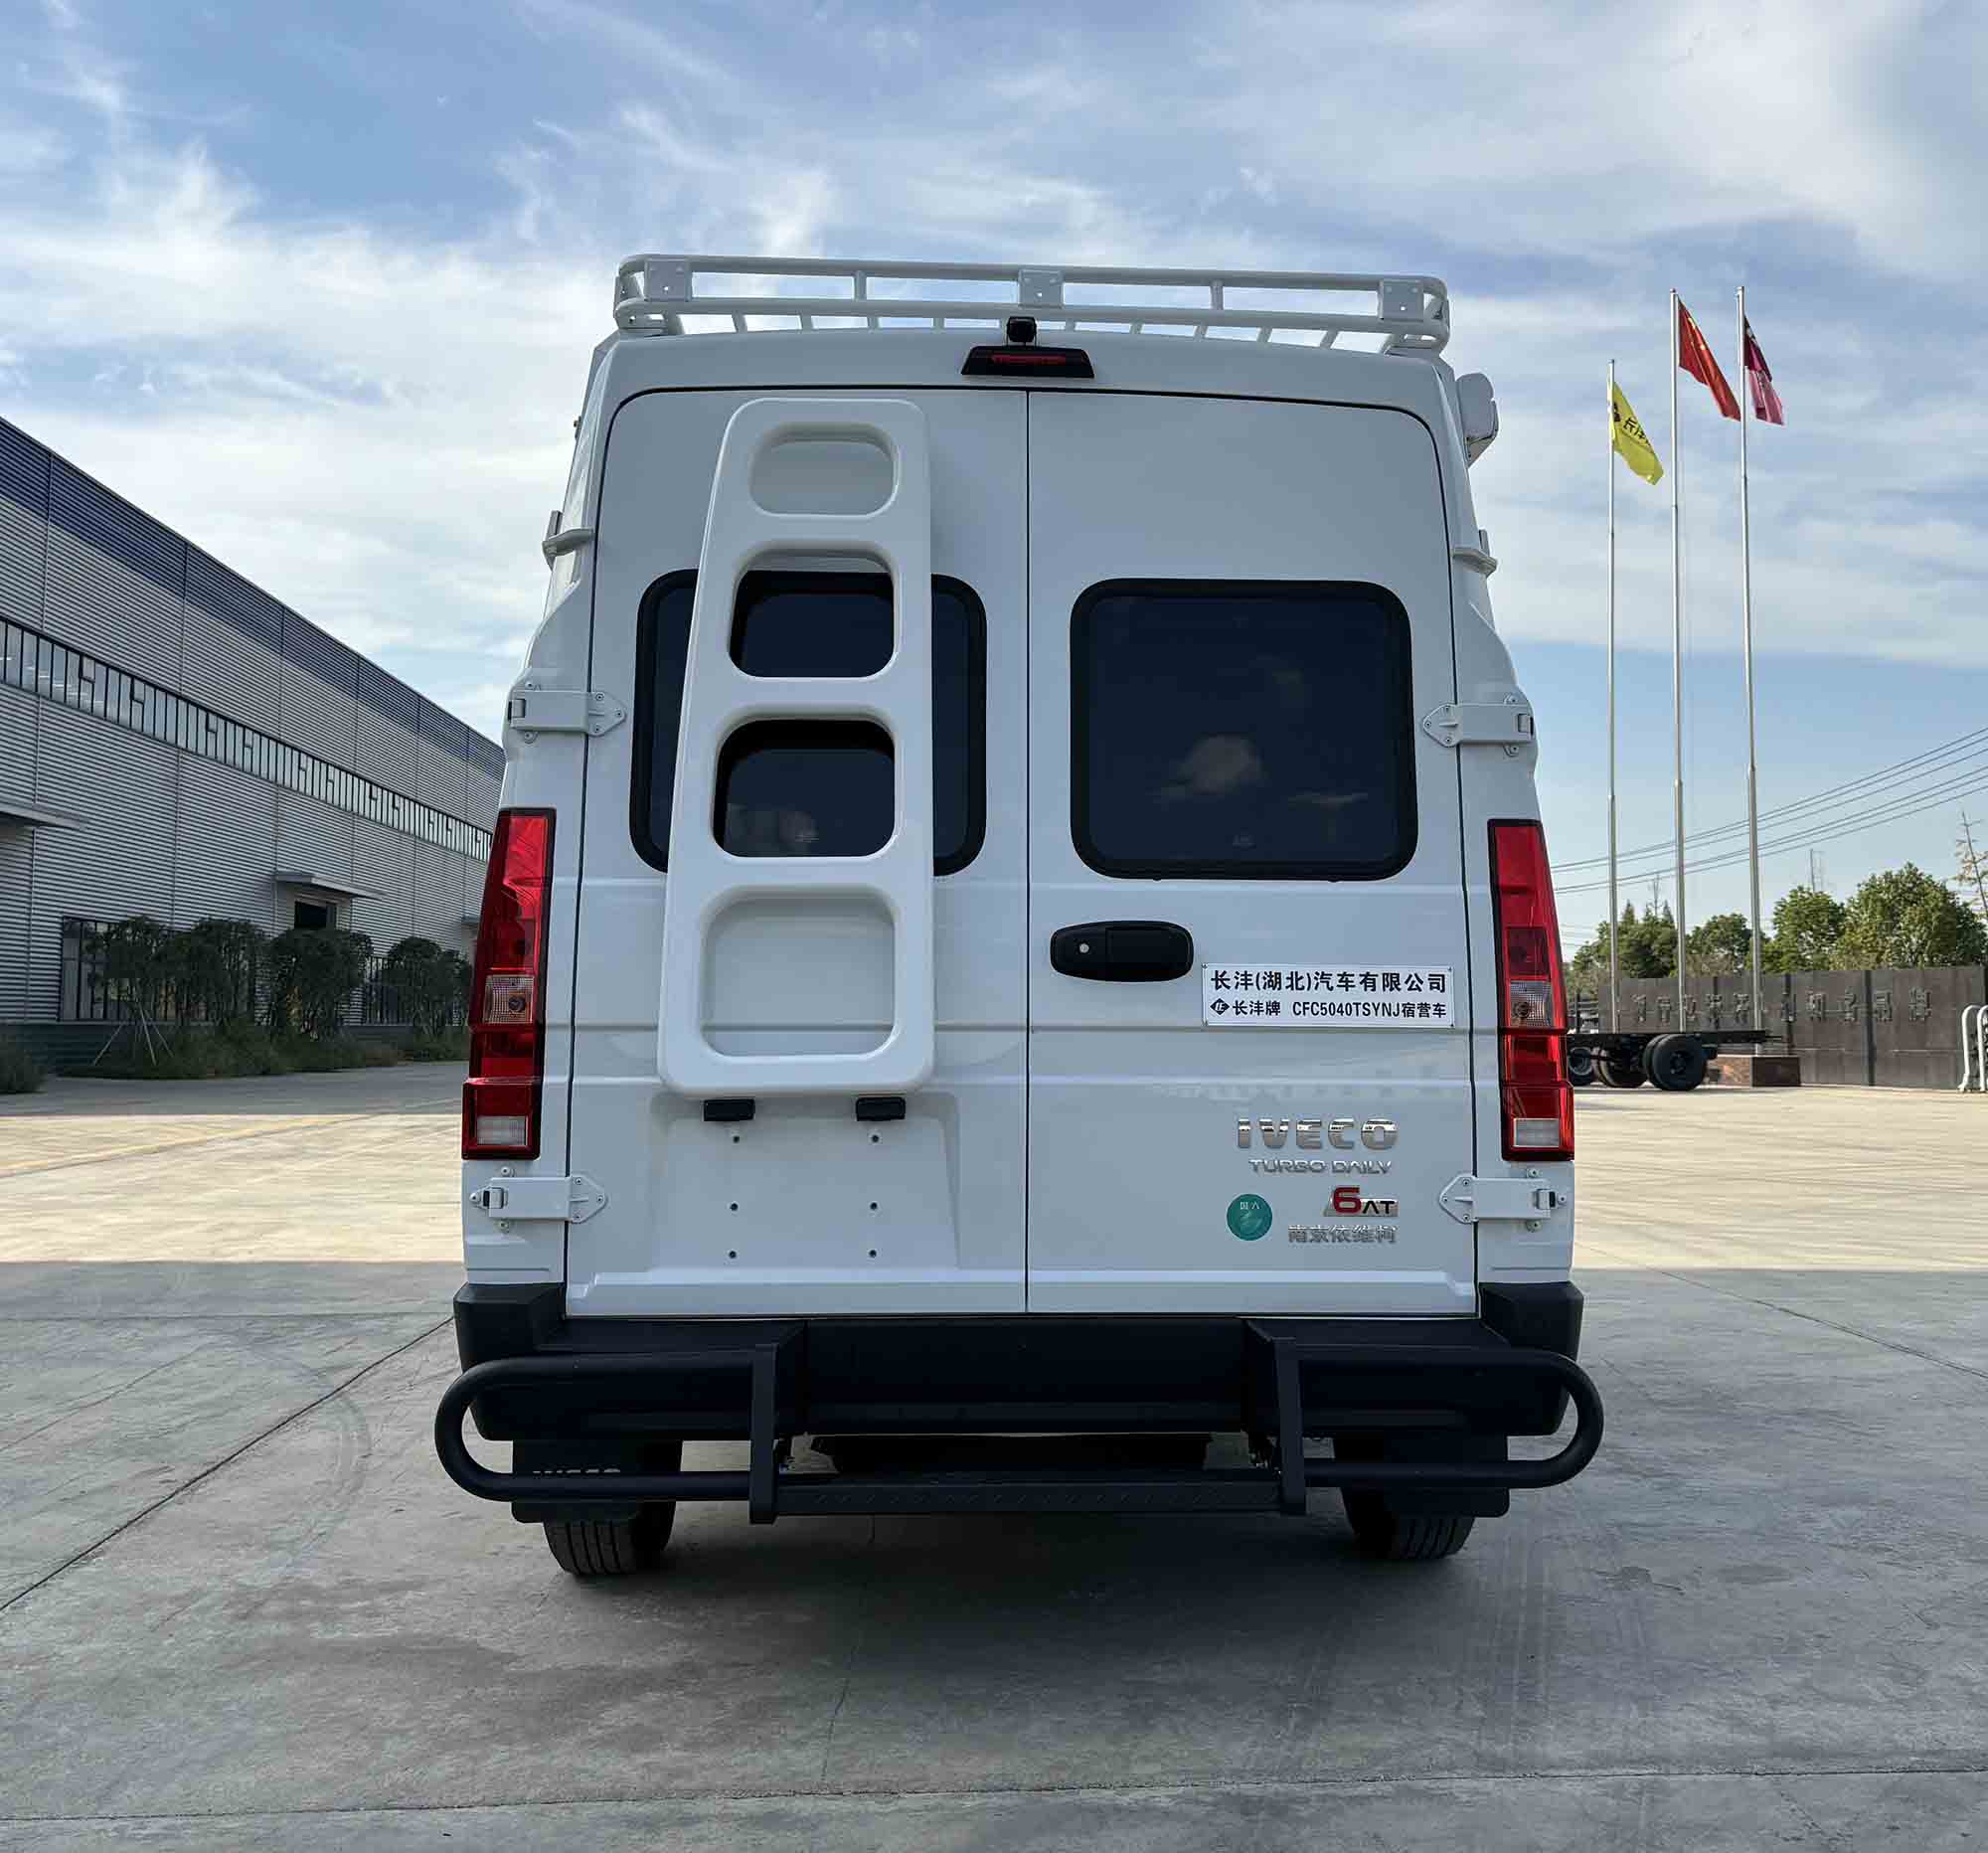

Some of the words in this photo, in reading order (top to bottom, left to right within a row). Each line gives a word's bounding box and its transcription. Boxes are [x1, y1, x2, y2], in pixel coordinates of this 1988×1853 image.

[1211, 970, 1446, 993] 长沣(湖北)汽车有限公司
[1233, 1000, 1281, 1016] 长沣牌
[1238, 1118, 1399, 1150] IVECO
[1248, 1158, 1326, 1174] TURBO
[1332, 1159, 1392, 1174] DAILY
